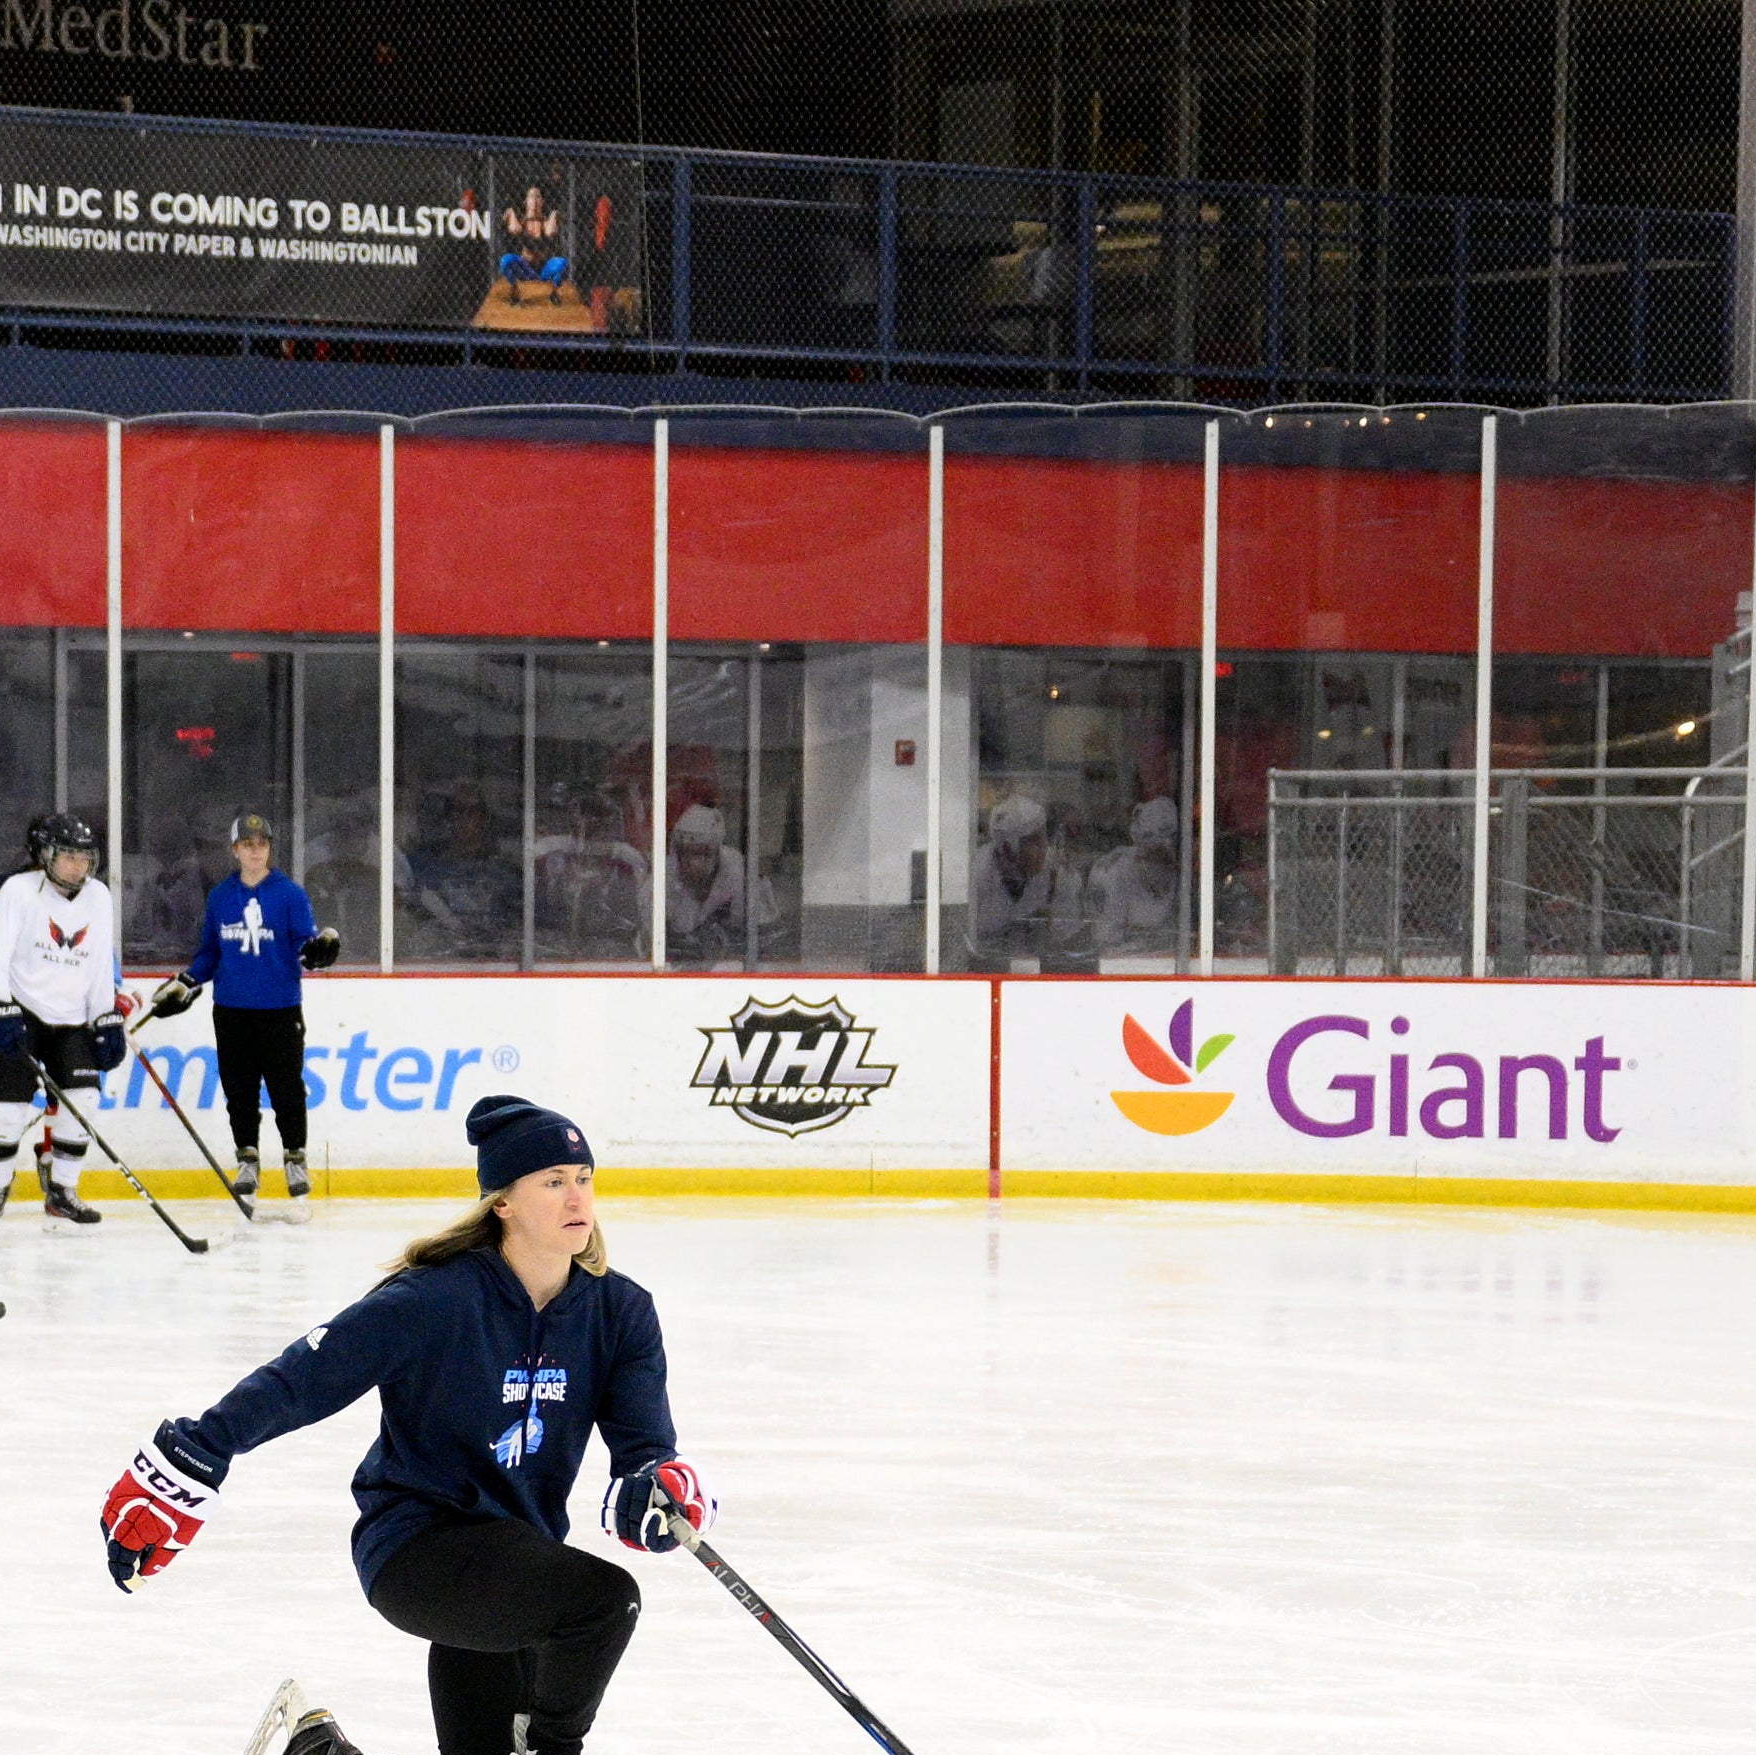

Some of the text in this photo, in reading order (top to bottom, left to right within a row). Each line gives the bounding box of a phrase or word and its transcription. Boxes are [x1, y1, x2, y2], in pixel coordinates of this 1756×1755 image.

[14, 183, 46, 217] IN
[56, 186, 103, 220] DC
[114, 189, 140, 222] IS
[149, 191, 280, 229] COMING
[287, 199, 331, 232] TO
[340, 201, 492, 241] BALLSTON
[124, 231, 171, 255] CITY
[173, 233, 237, 258] PAPER
[239, 236, 253, 259] &
[258, 238, 418, 267] WASHINGTONIAN
[695, 1031, 895, 1085] NHL
[1266, 1014, 1624, 1144] Giant
[713, 1085, 870, 1104] NETWORK
[503, 1368, 567, 1383] PWHPA
[132, 1447, 208, 1509] CCM
[173, 1446, 214, 1474] STEPHENSON
[705, 1560, 772, 1624] ALPHA
